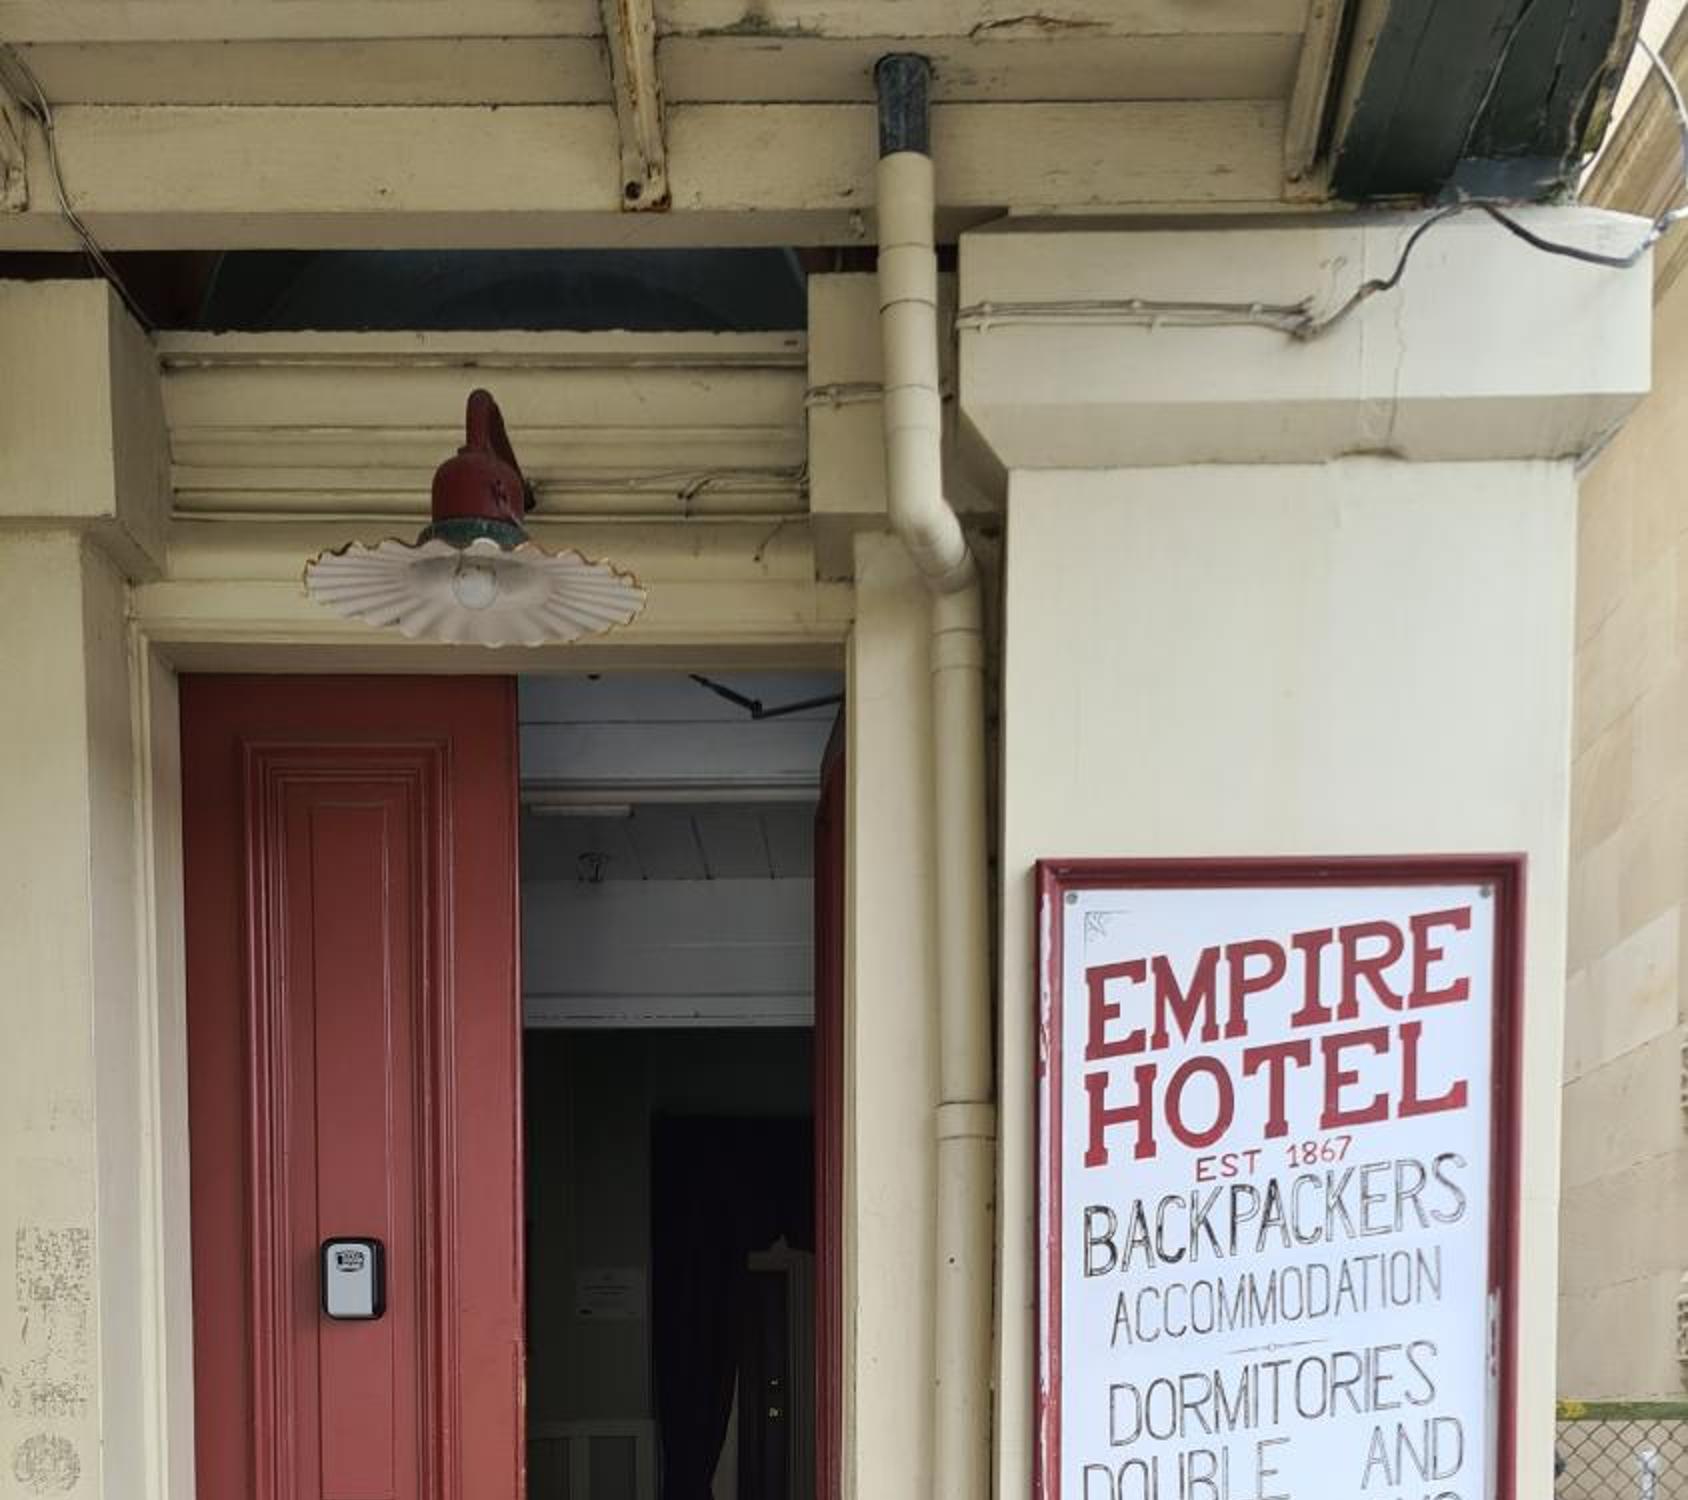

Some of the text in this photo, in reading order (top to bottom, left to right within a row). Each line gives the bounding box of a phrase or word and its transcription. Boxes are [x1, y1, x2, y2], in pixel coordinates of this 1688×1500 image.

[1085, 907, 1471, 1061] EMPIRE
[1085, 1021, 1467, 1168] HOTEL
[1196, 1135, 1352, 1183] EST 1867
[1084, 1152, 1467, 1278] BACKPACKERS
[1110, 1246, 1441, 1348] ACCOMMODATION
[1110, 1340, 1437, 1447] DORMITORIES
[1361, 1417, 1464, 1490] AND
